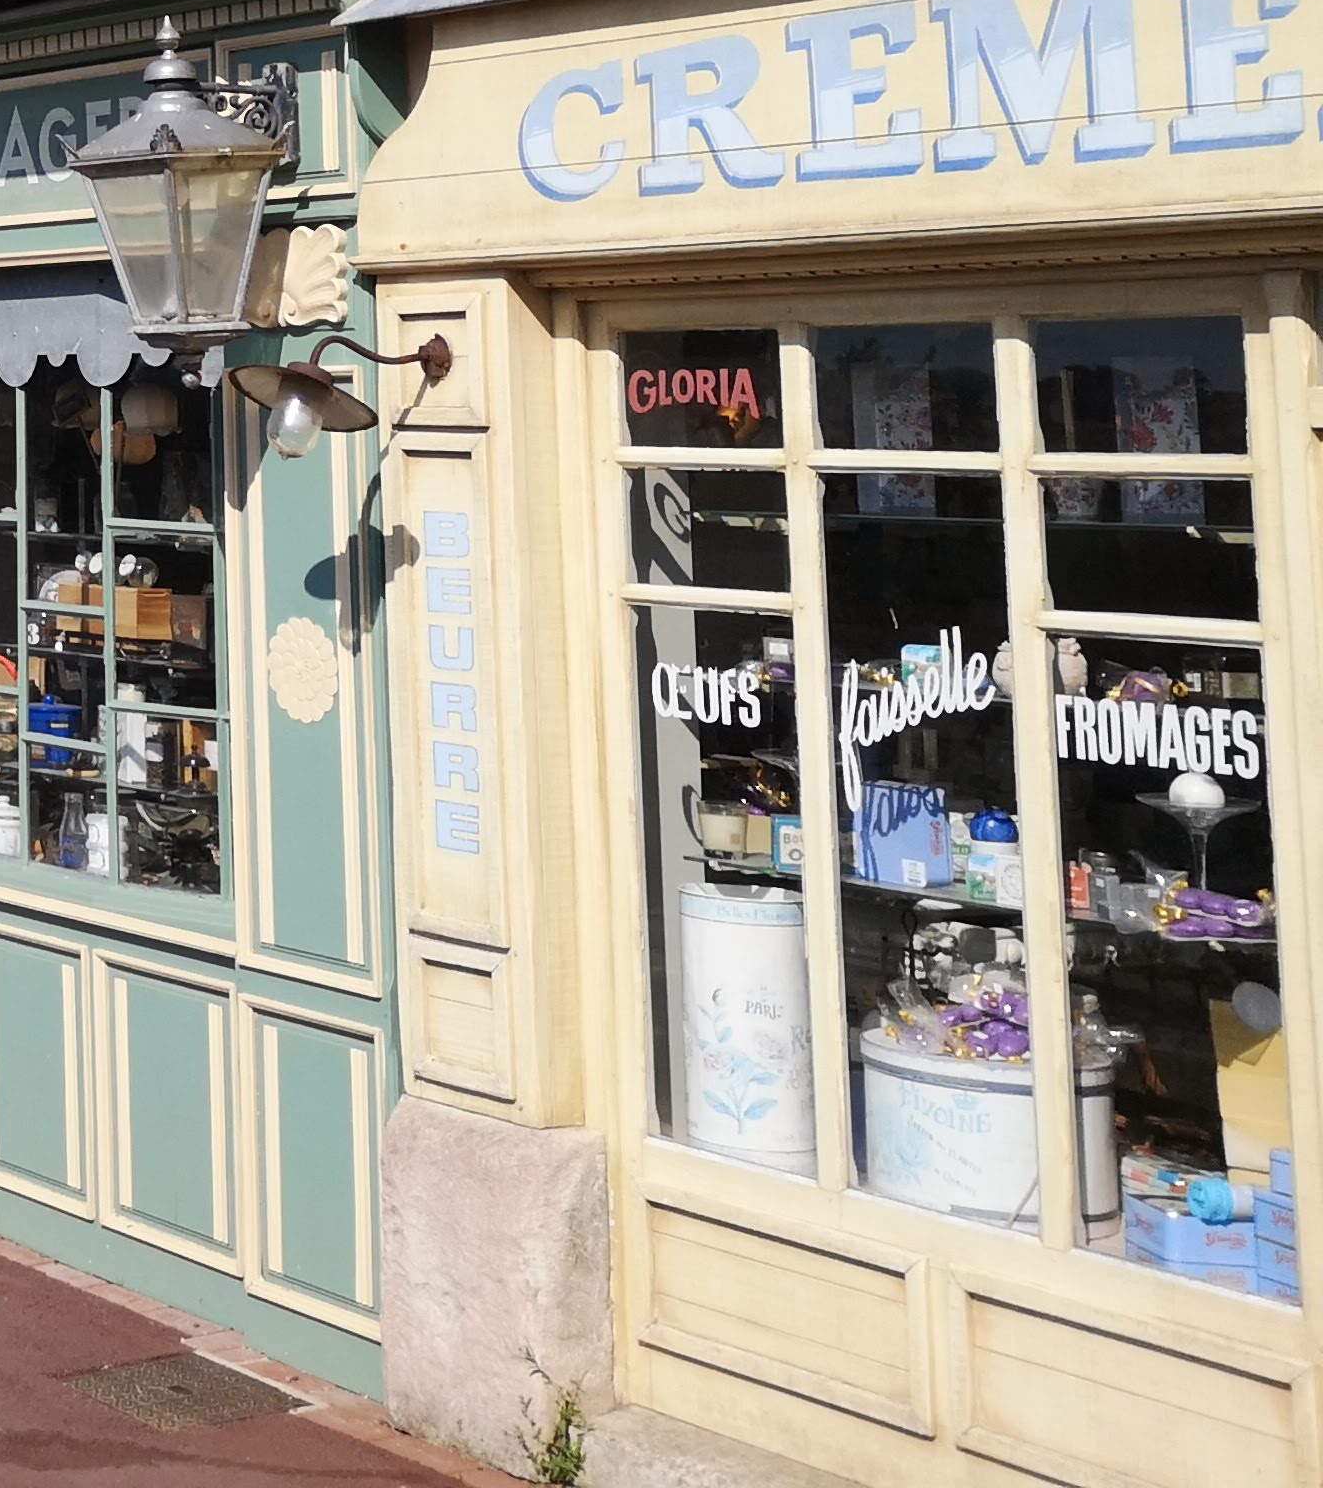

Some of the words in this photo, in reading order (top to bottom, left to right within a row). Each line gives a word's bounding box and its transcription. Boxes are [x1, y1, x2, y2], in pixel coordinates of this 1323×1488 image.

[628, 367, 760, 420] GLORIA
[423, 510, 482, 855] BEURRE
[652, 661, 762, 729] ŒUFS
[1055, 694, 1259, 780] FROMAGES
